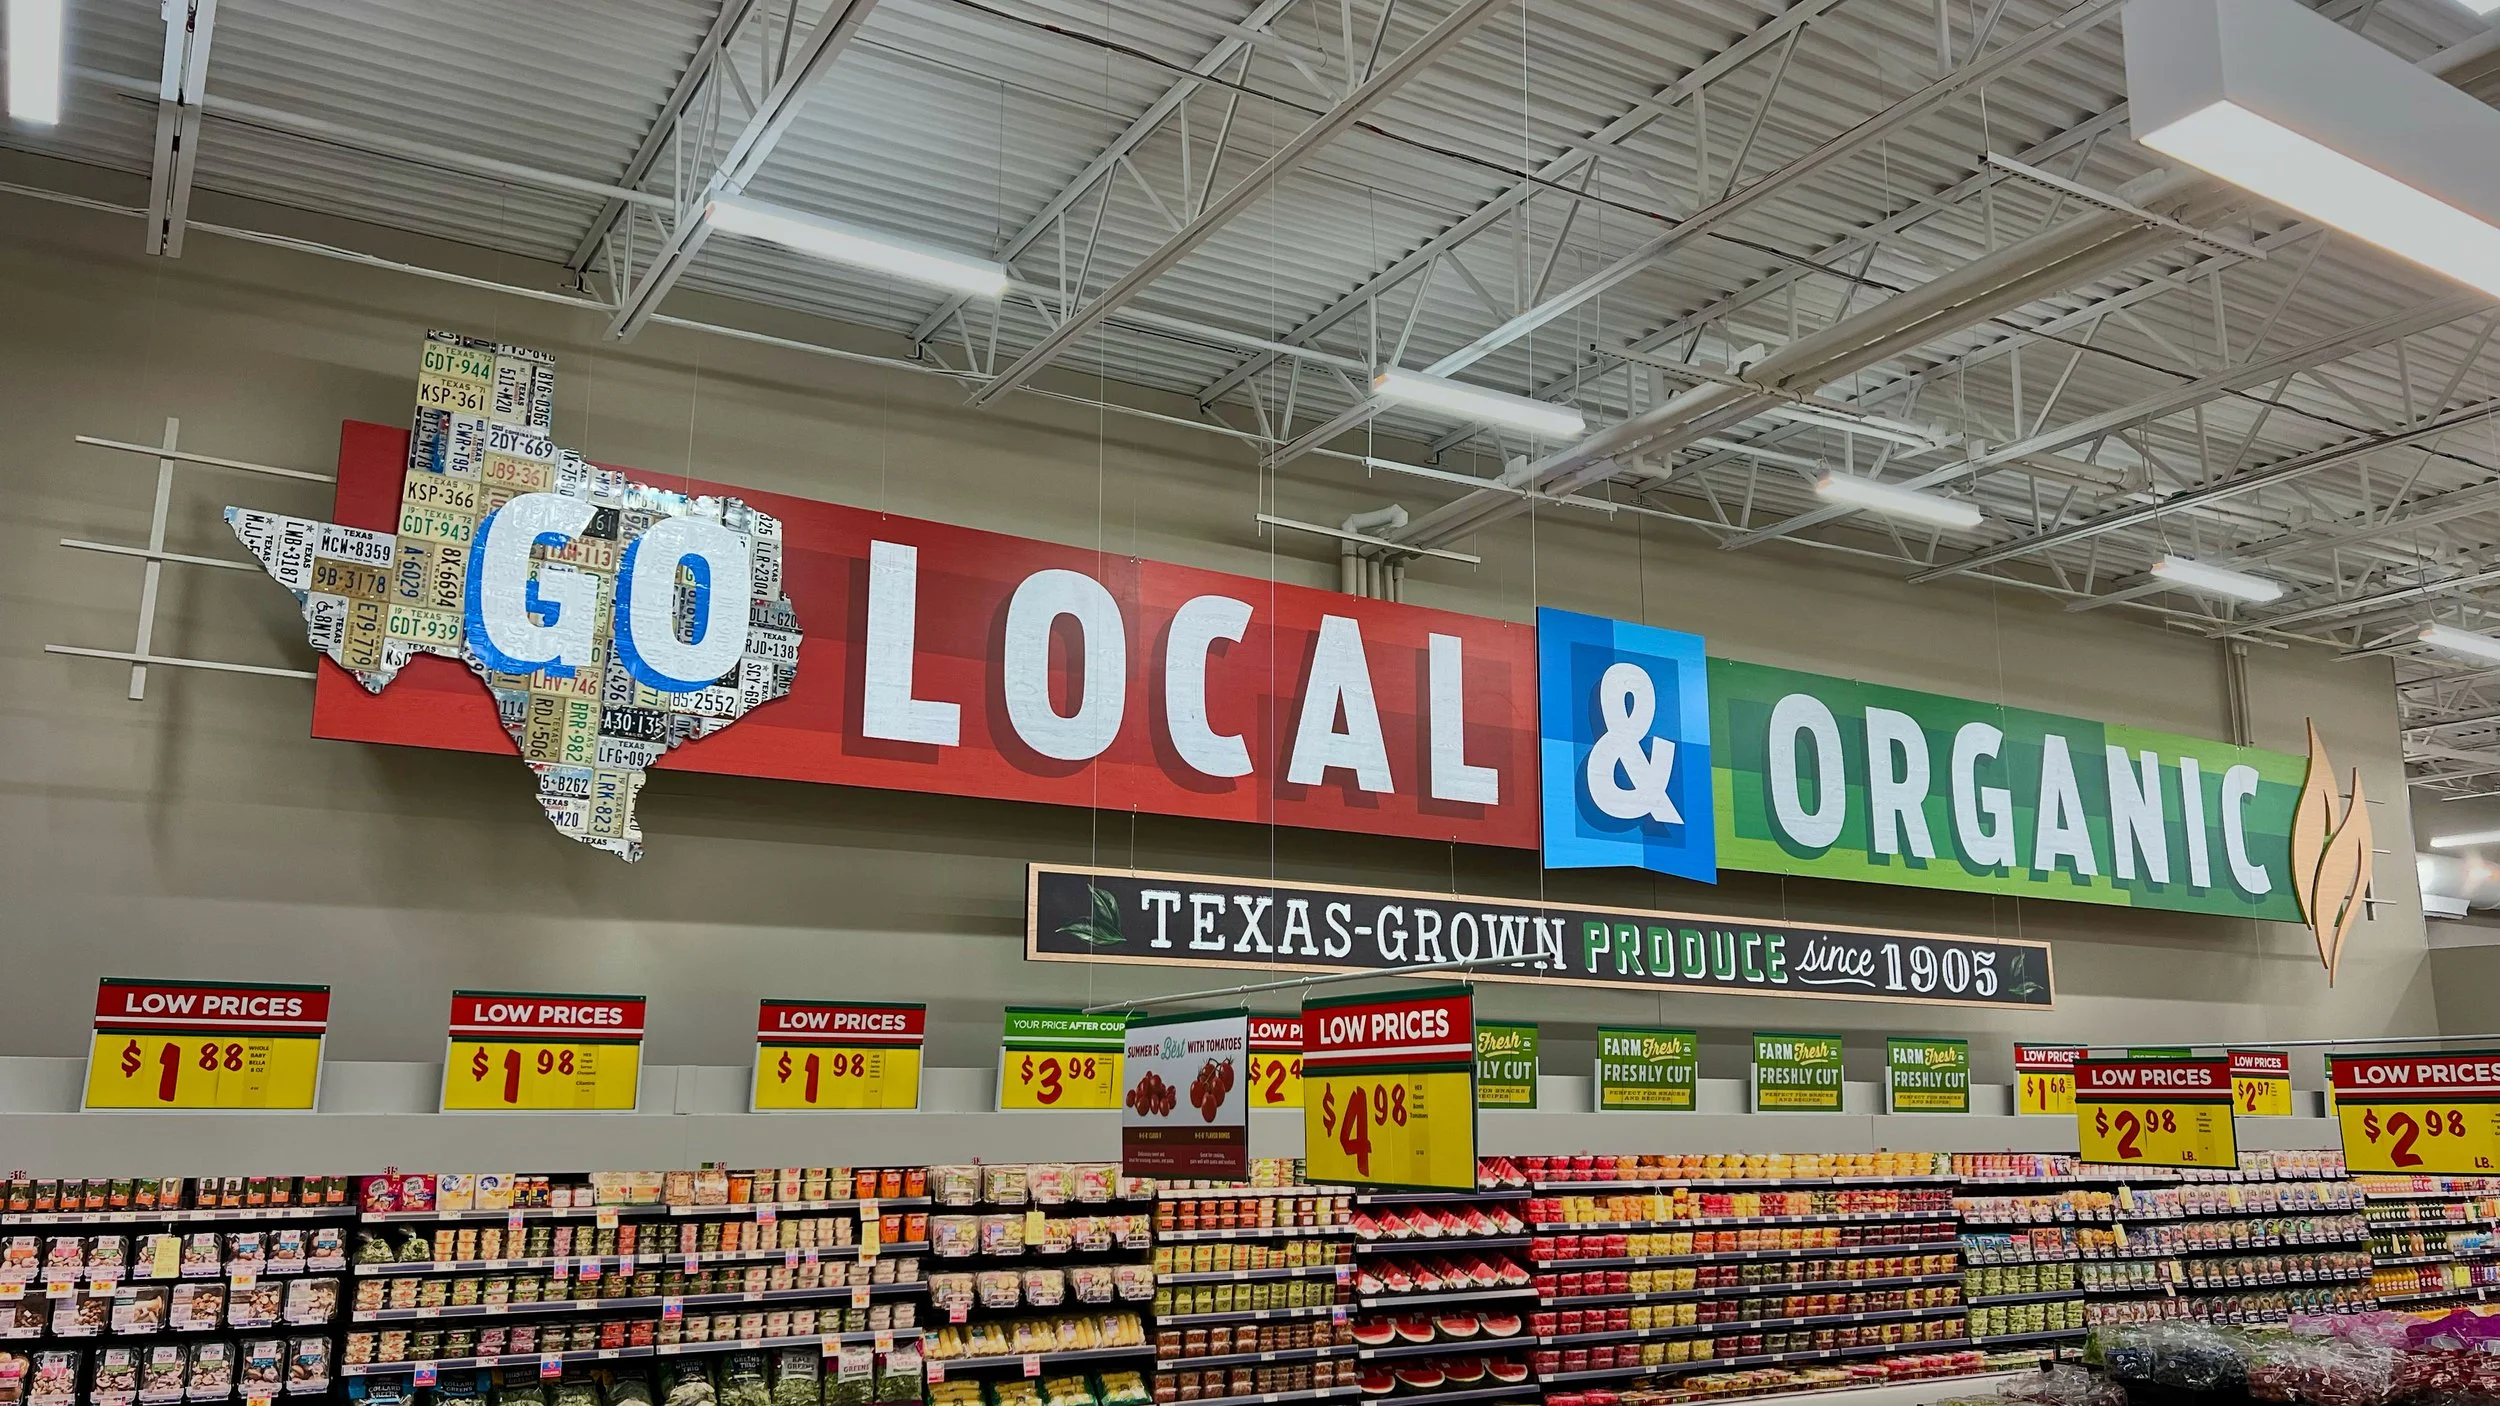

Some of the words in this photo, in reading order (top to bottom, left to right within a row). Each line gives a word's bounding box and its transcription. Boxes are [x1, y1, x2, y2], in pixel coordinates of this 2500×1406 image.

[446, 347, 475, 360] TEXAS
[441, 379, 471, 391] TEXAS
[518, 382, 527, 406] TEXAS
[474, 437, 484, 462] TEXAS
[429, 476, 460, 490] TEXAS
[425, 509, 455, 521] TEXAS
[343, 528, 373, 541] TEXAS
[263, 535, 274, 562] TEXAS
[303, 542, 314, 569] TEXAS
[478, 492, 752, 685] GO
[411, 608, 442, 620] TEXAS
[333, 617, 344, 644] TEXAS
[762, 632, 787, 642] TEXAS
[407, 642, 437, 653] TEXAS
[863, 538, 1500, 807] LOCAL
[550, 716, 561, 744] TEXAS
[587, 720, 597, 749] TEXAS
[618, 740, 645, 750] TEXAS
[1587, 661, 1684, 825] &
[541, 797, 569, 808] TEXAS
[614, 790, 625, 818] TEXAS
[1768, 692, 2273, 896] ORGANIC
[580, 835, 608, 847] TEXAS
[1140, 888, 1568, 971] TEXAS-GROWN
[1583, 919, 1789, 985] PRODUCE
[1795, 934, 1876, 977] since
[1880, 942, 1998, 996] 1905
[125, 992, 197, 1014] LOW
[202, 995, 303, 1018] PRICES
[474, 1003, 535, 1024] LOW
[538, 1005, 623, 1025] PRICES
[778, 1011, 831, 1030] LOW
[833, 1012, 906, 1031] PRICES
[1013, 1019, 1040, 1029] YOUR
[1041, 1020, 1068, 1030] PRICE
[1068, 1021, 1099, 1031] AFTER
[1099, 1022, 1126, 1031] COUP
[1250, 1022, 1287, 1038] LOW
[1319, 1014, 1367, 1045] LOW
[1371, 1008, 1450, 1042] PRICES
[1127, 1044, 1153, 1058] SUMMER
[1153, 1043, 1160, 1056] IS
[1160, 1036, 1186, 1061] Best
[1187, 1038, 1205, 1054] WITH
[1206, 1036, 1242, 1052] TOMATOES
[1478, 1031, 1522, 1053] Fresh
[1604, 1037, 1641, 1056] FARM
[1642, 1037, 1682, 1058] Fresh
[1759, 1042, 1793, 1060] FARM
[1794, 1041, 1829, 1062] Fresh
[1893, 1047, 1924, 1065] FARM
[1924, 1047, 1957, 1067] Fresh
[2023, 1050, 2046, 1062] LOW
[2234, 1056, 2253, 1067] LOW
[2254, 1057, 2281, 1068] PRICES
[1504, 1061, 1532, 1080] CUT
[1604, 1063, 1664, 1082] FRESHLY
[1666, 1065, 1692, 1083] CUT
[1759, 1067, 1813, 1085] FRESHLY
[1816, 1068, 1839, 1085] CUT
[1894, 1071, 1942, 1088] FRESHLY
[1945, 1072, 1966, 1088] CUT
[2091, 1069, 2137, 1086] LOW
[2140, 1069, 2212, 1086] PRICES
[2353, 1065, 2410, 1084] LOW
[2416, 1063, 2500, 1083] PRICES
